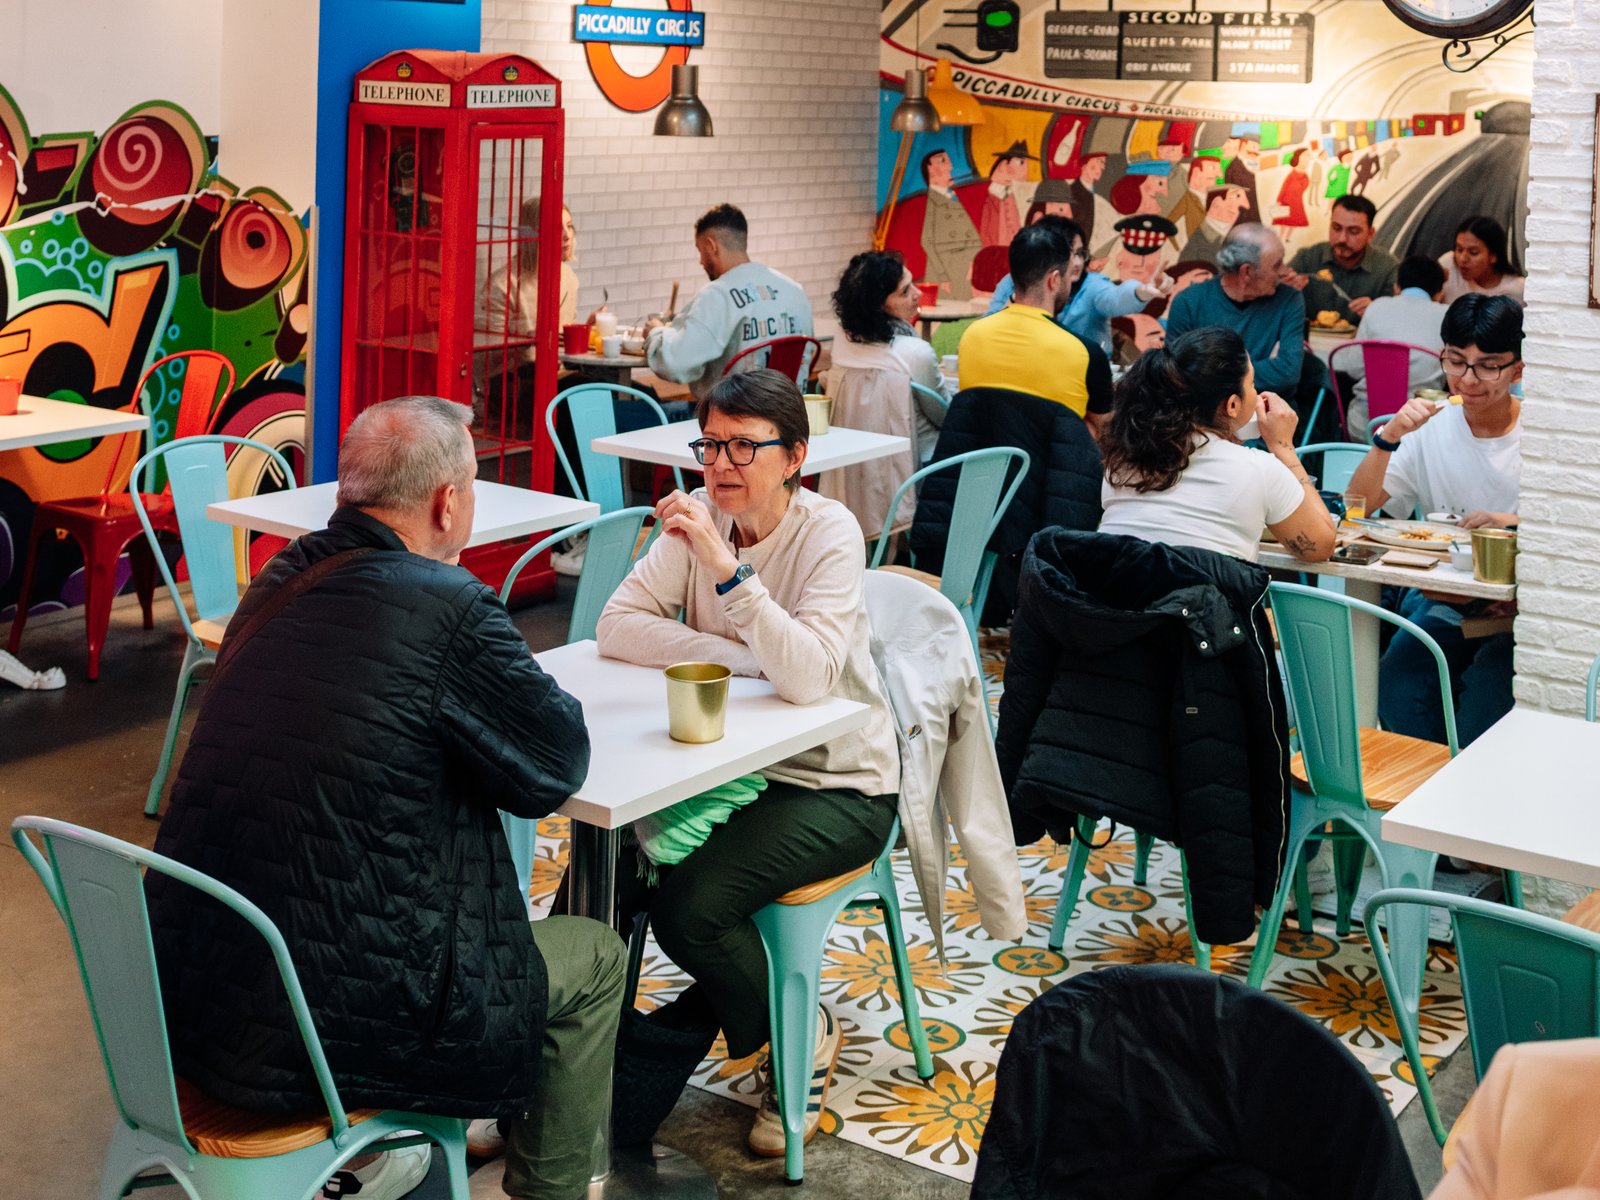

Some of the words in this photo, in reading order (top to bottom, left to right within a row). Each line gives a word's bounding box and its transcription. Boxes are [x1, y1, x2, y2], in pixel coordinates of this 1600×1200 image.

[577, 13, 651, 35] PICCADILLY
[1128, 10, 1213, 24] SECOND
[1223, 11, 1300, 26] FIRST
[1181, 36, 1213, 49] PARK
[1150, 62, 1193, 73] AVENUE
[361, 84, 446, 103] TELEPHONE
[470, 88, 552, 104] TELEPHONE
[952, 70, 1062, 103] PICCADILLY
[1065, 95, 1121, 113] CIRCUS
